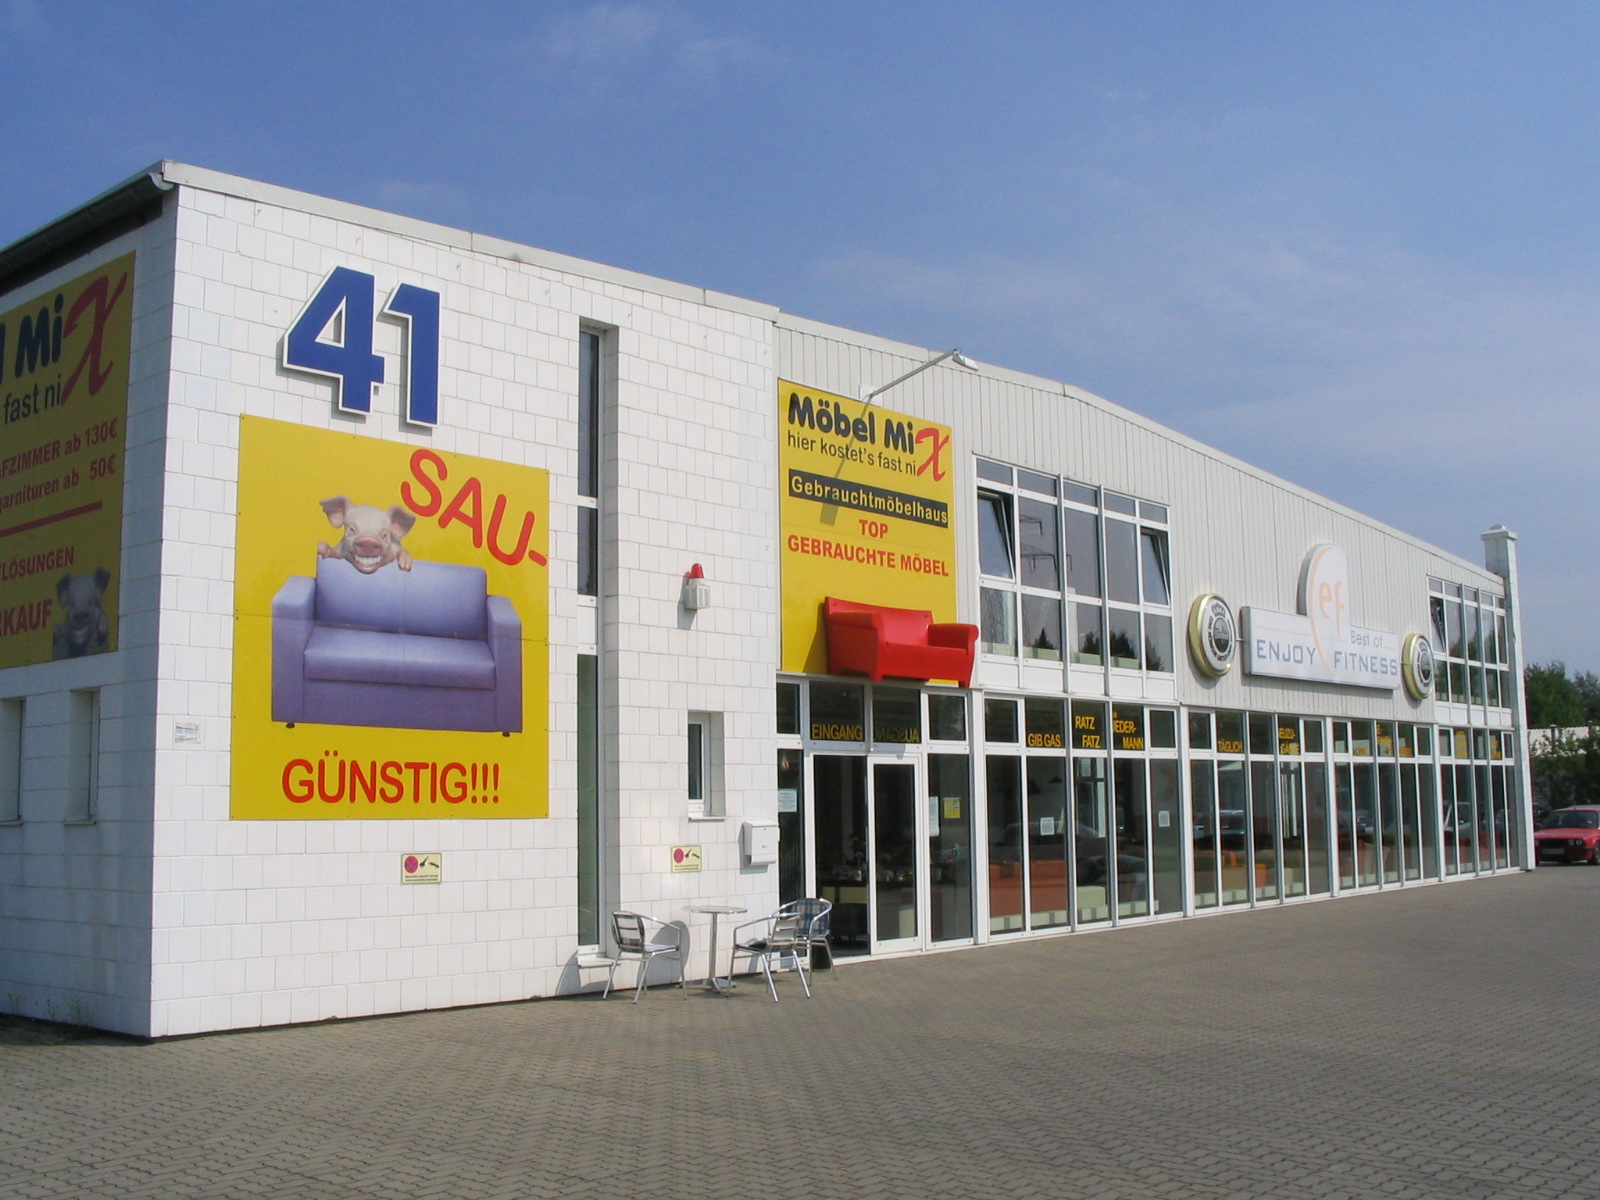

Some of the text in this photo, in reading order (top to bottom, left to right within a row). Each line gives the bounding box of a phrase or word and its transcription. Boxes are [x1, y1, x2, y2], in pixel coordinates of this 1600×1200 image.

[283, 265, 440, 427] 41
[4, 384, 39, 425] fast
[788, 392, 875, 444] Möbel
[0, 418, 117, 479] FZIMMER ab 130€
[787, 431, 816, 451] hier
[820, 437, 874, 466] kostet's
[877, 454, 902, 473] fast
[63, 467, 79, 489] ab
[89, 454, 116, 480] 50€
[400, 449, 547, 567] SAU-
[791, 475, 948, 523] Gebrauchtmöbelhaus
[859, 519, 889, 539] TOP
[0, 546, 74, 581] LÖSUNGEN
[787, 534, 949, 577] GEBRAUCHTE MÖBEL
[0, 599, 53, 637] KAUF
[1256, 638, 1316, 665] ENJOY
[1333, 650, 1398, 676] FITNESS
[1350, 630, 1384, 648] Best of
[811, 724, 864, 740] EINGANG
[1027, 733, 1061, 748] GIB GAS
[1075, 716, 1095, 730] RATZ
[1082, 735, 1101, 748] FATZ
[1112, 720, 1137, 733] IEDER-
[1122, 736, 1144, 750] MANN
[281, 749, 501, 804] GÜNSTIG!!!
